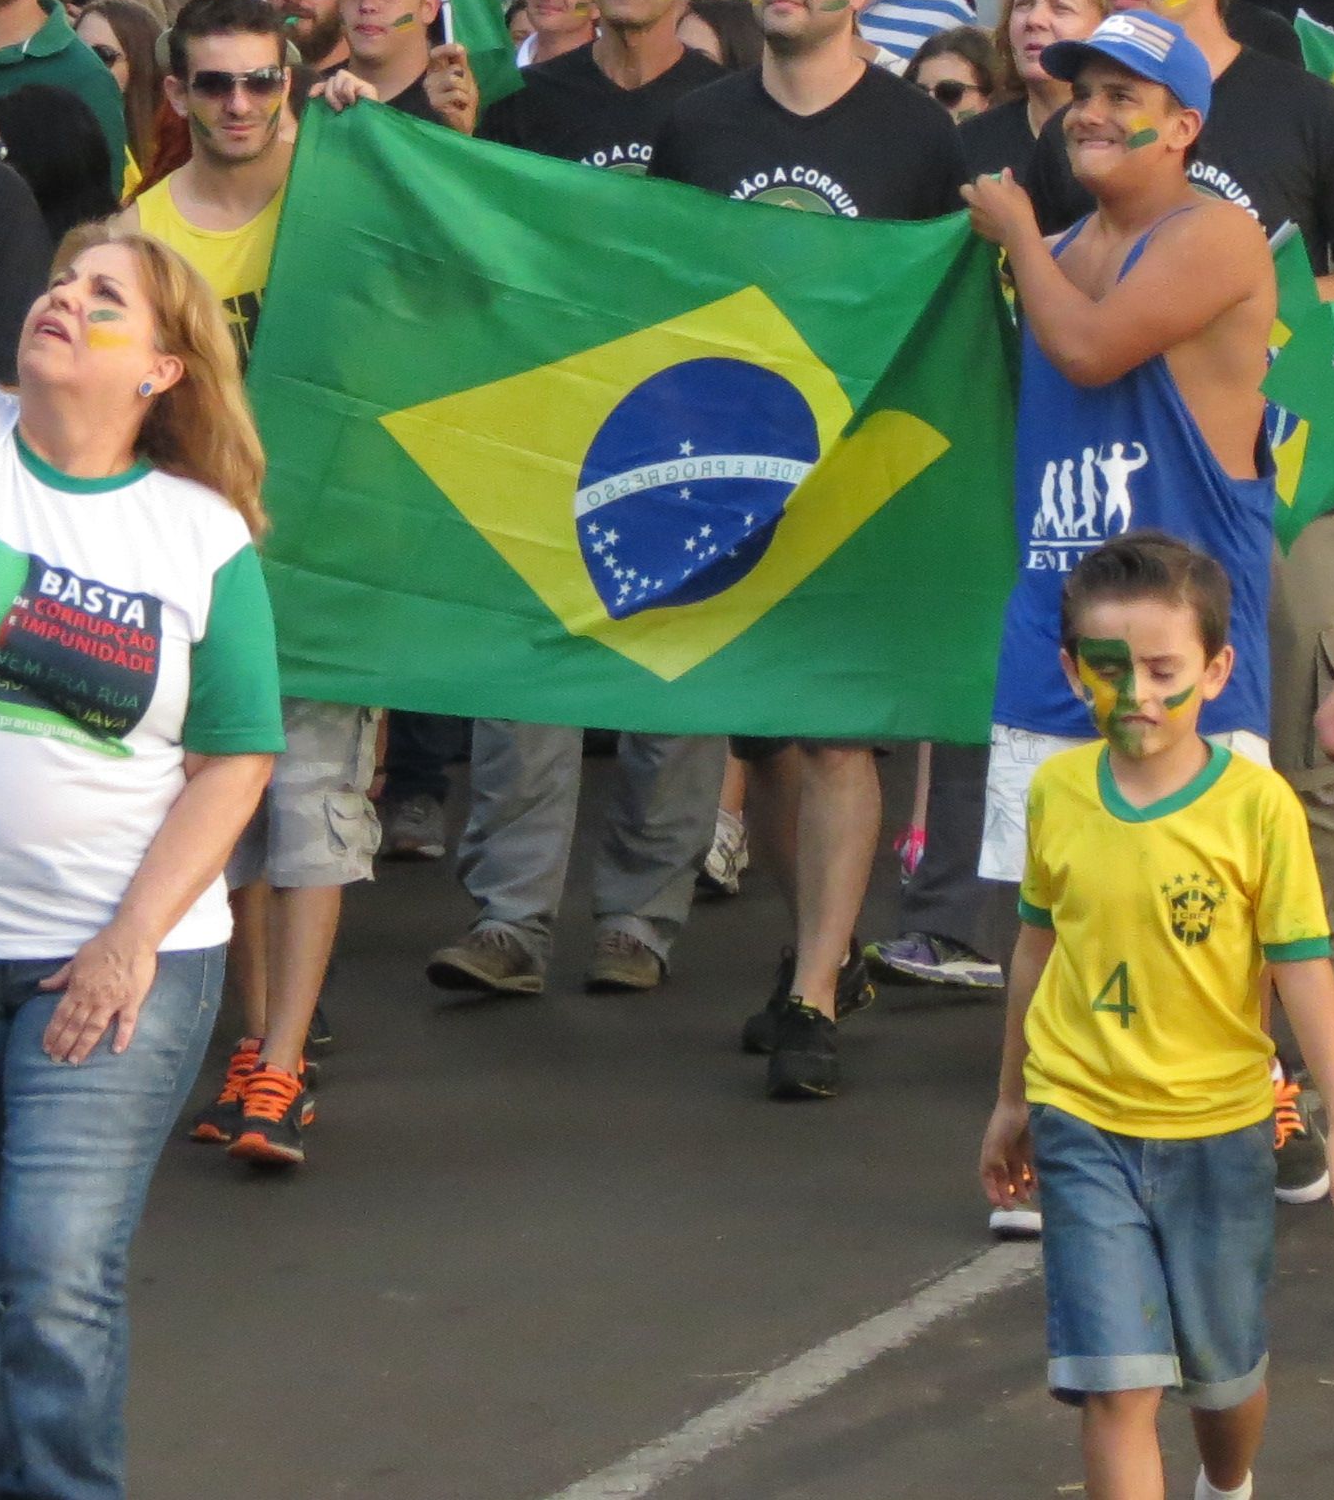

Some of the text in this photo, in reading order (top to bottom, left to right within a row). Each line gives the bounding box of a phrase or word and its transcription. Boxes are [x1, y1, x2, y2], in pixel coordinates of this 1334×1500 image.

[773, 166, 787, 183] A
[791, 165, 860, 219] CORRUP
[1185, 161, 1259, 220] ORRUP
[12, 595, 156, 652] DE CORRUPÇÃO
[39, 569, 145, 629] BASTA
[8, 615, 155, 675] E IMPUNIDADE
[1092, 960, 1137, 1029] 4
